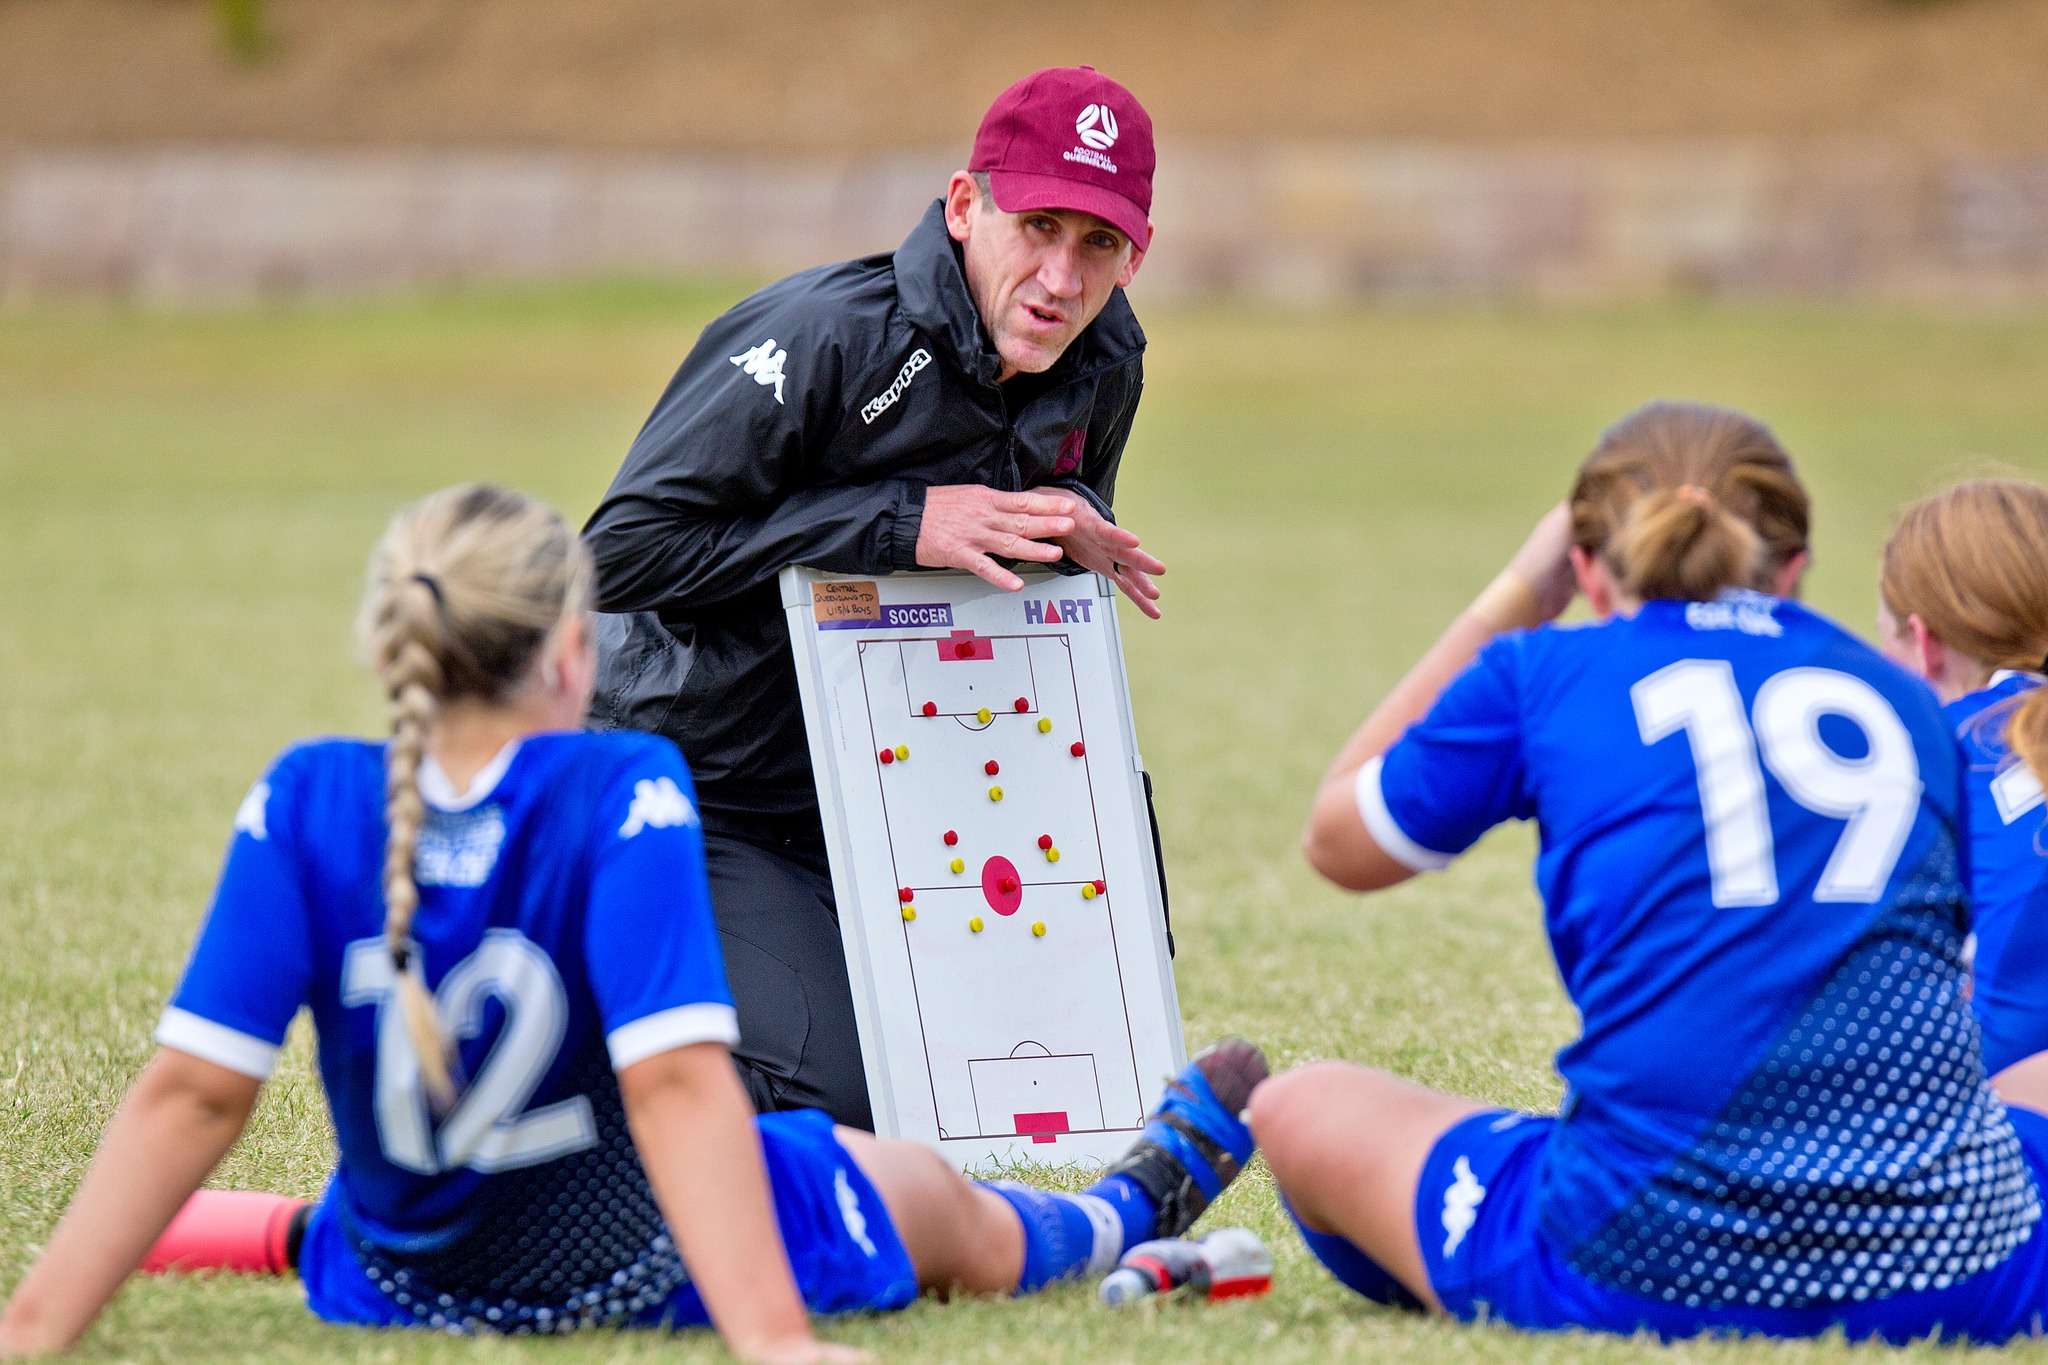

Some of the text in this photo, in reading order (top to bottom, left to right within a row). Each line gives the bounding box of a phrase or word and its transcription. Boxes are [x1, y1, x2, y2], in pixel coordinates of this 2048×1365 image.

[1063, 151, 1117, 174] QUEENSLAND
[1073, 146, 1111, 163] FOOTBALL
[861, 348, 932, 425] Kappa
[826, 583, 858, 593] CENTRAL
[888, 608, 948, 625] SOCCER
[1024, 599, 1093, 624] HART
[1630, 658, 1924, 909] 19
[340, 927, 600, 1176] 12
